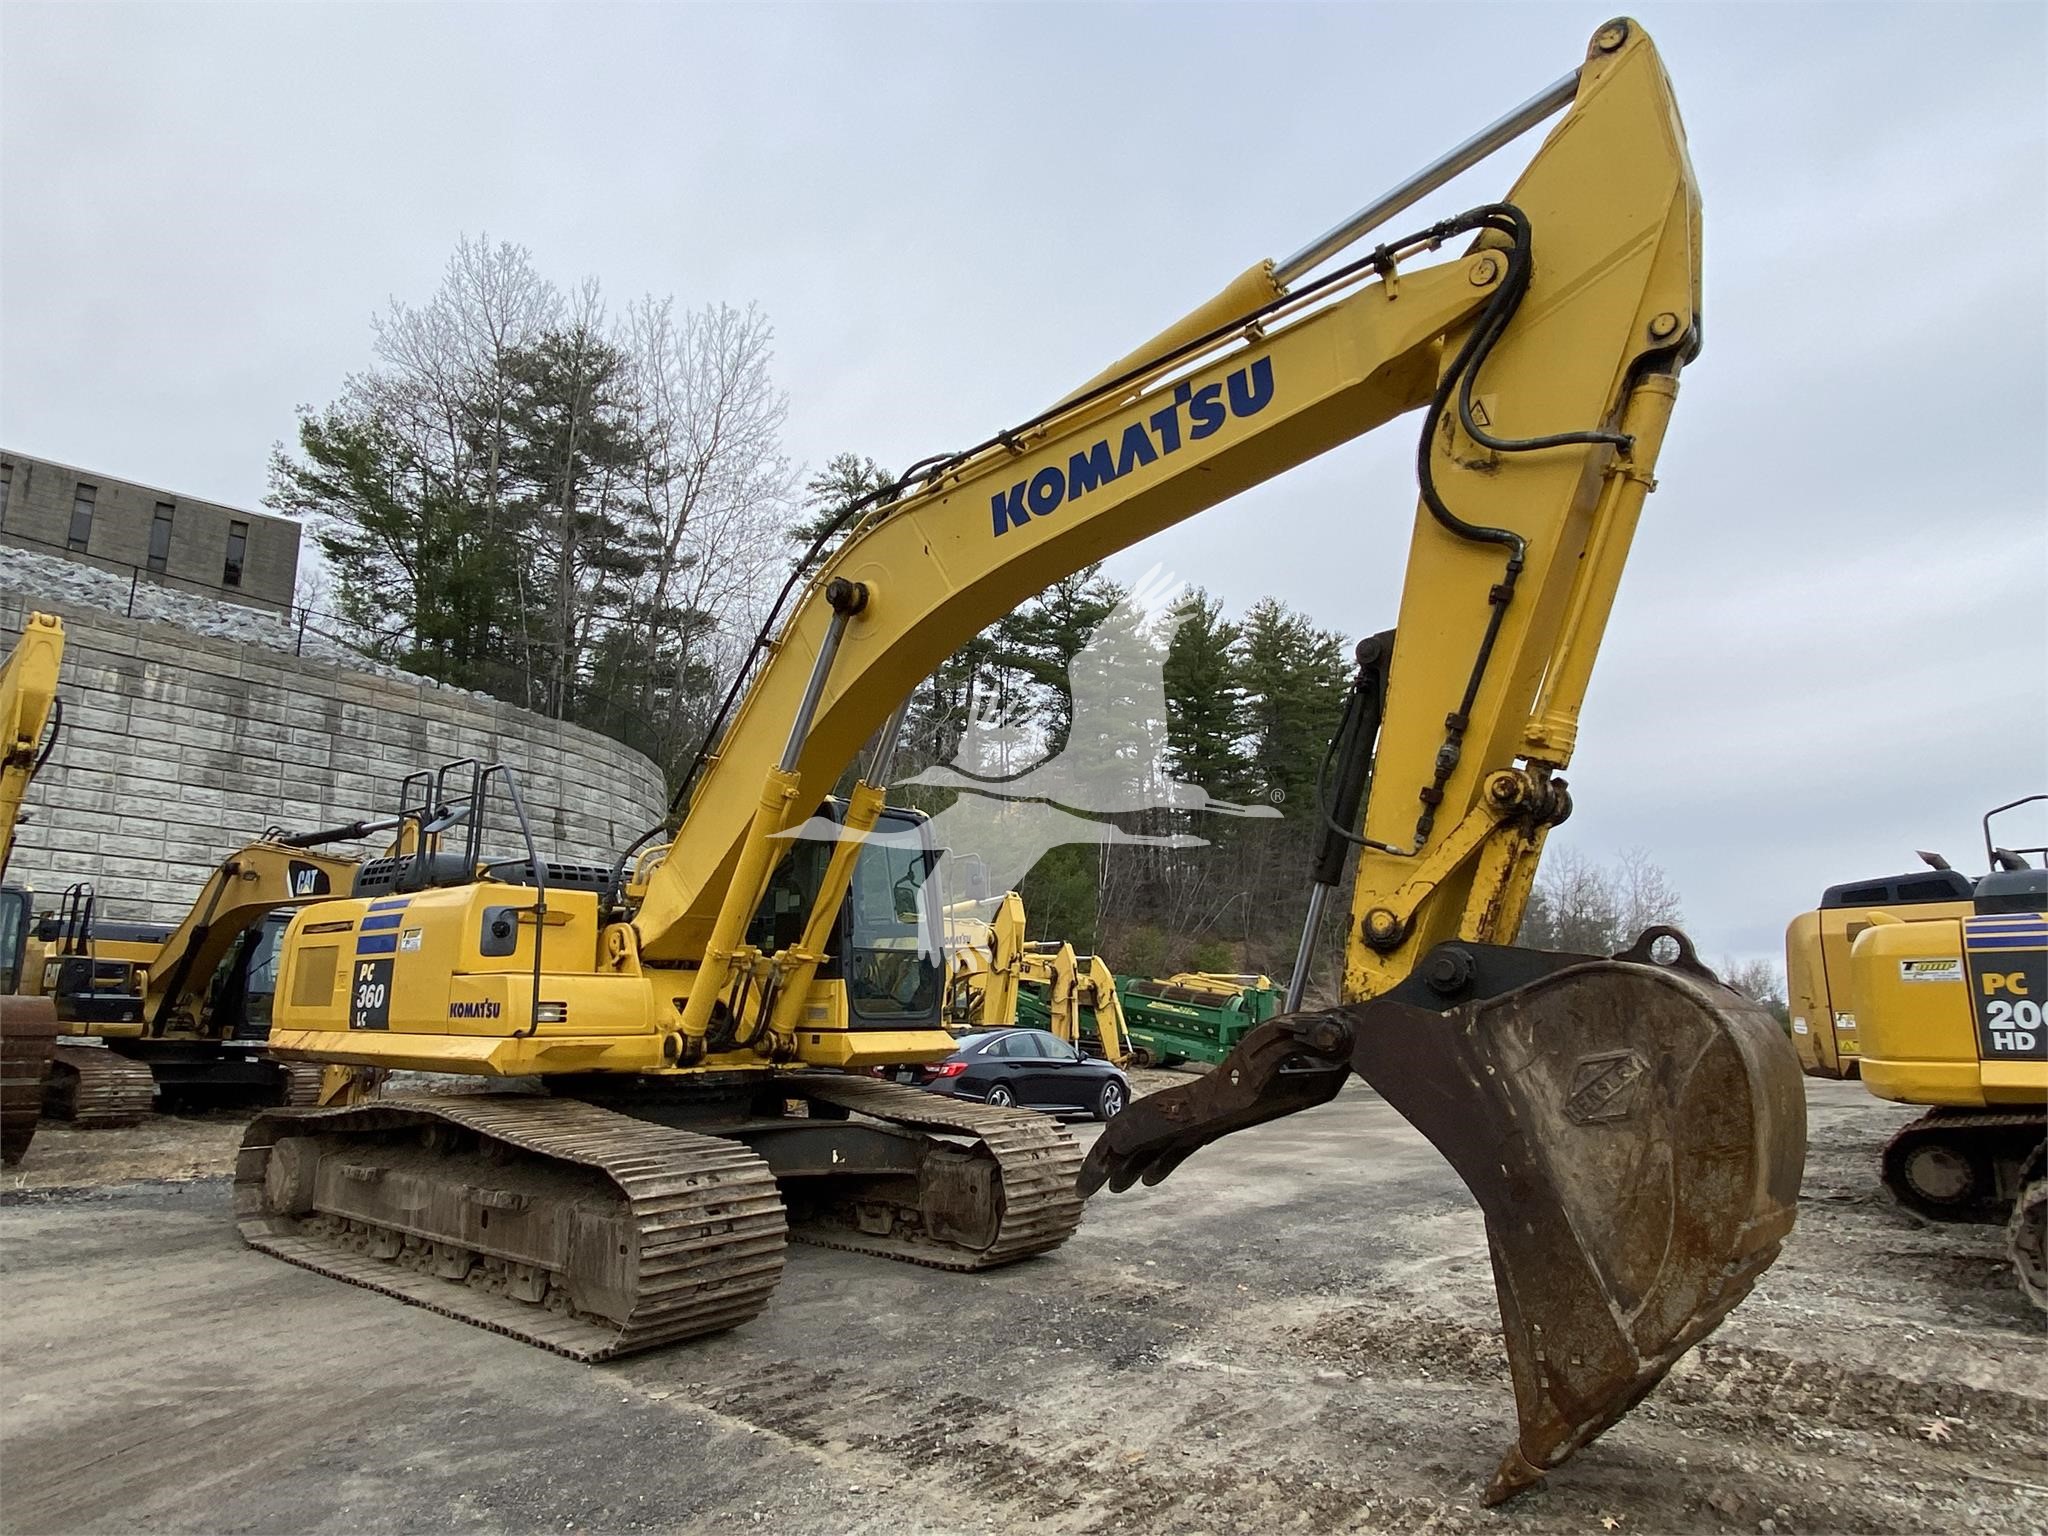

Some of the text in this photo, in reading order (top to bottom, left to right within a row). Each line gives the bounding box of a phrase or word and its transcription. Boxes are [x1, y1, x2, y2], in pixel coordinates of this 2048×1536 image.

[991, 355, 1275, 537] KOMATSU
[296, 869, 318, 894] CAT
[359, 963, 376, 981] PC
[1981, 972, 2028, 995] PC
[356, 984, 385, 1009] 360
[449, 997, 501, 1018] KOMATSU
[356, 1011, 368, 1027] LC
[1986, 1000, 2048, 1030] 20
[1992, 1031, 2036, 1051] HD
